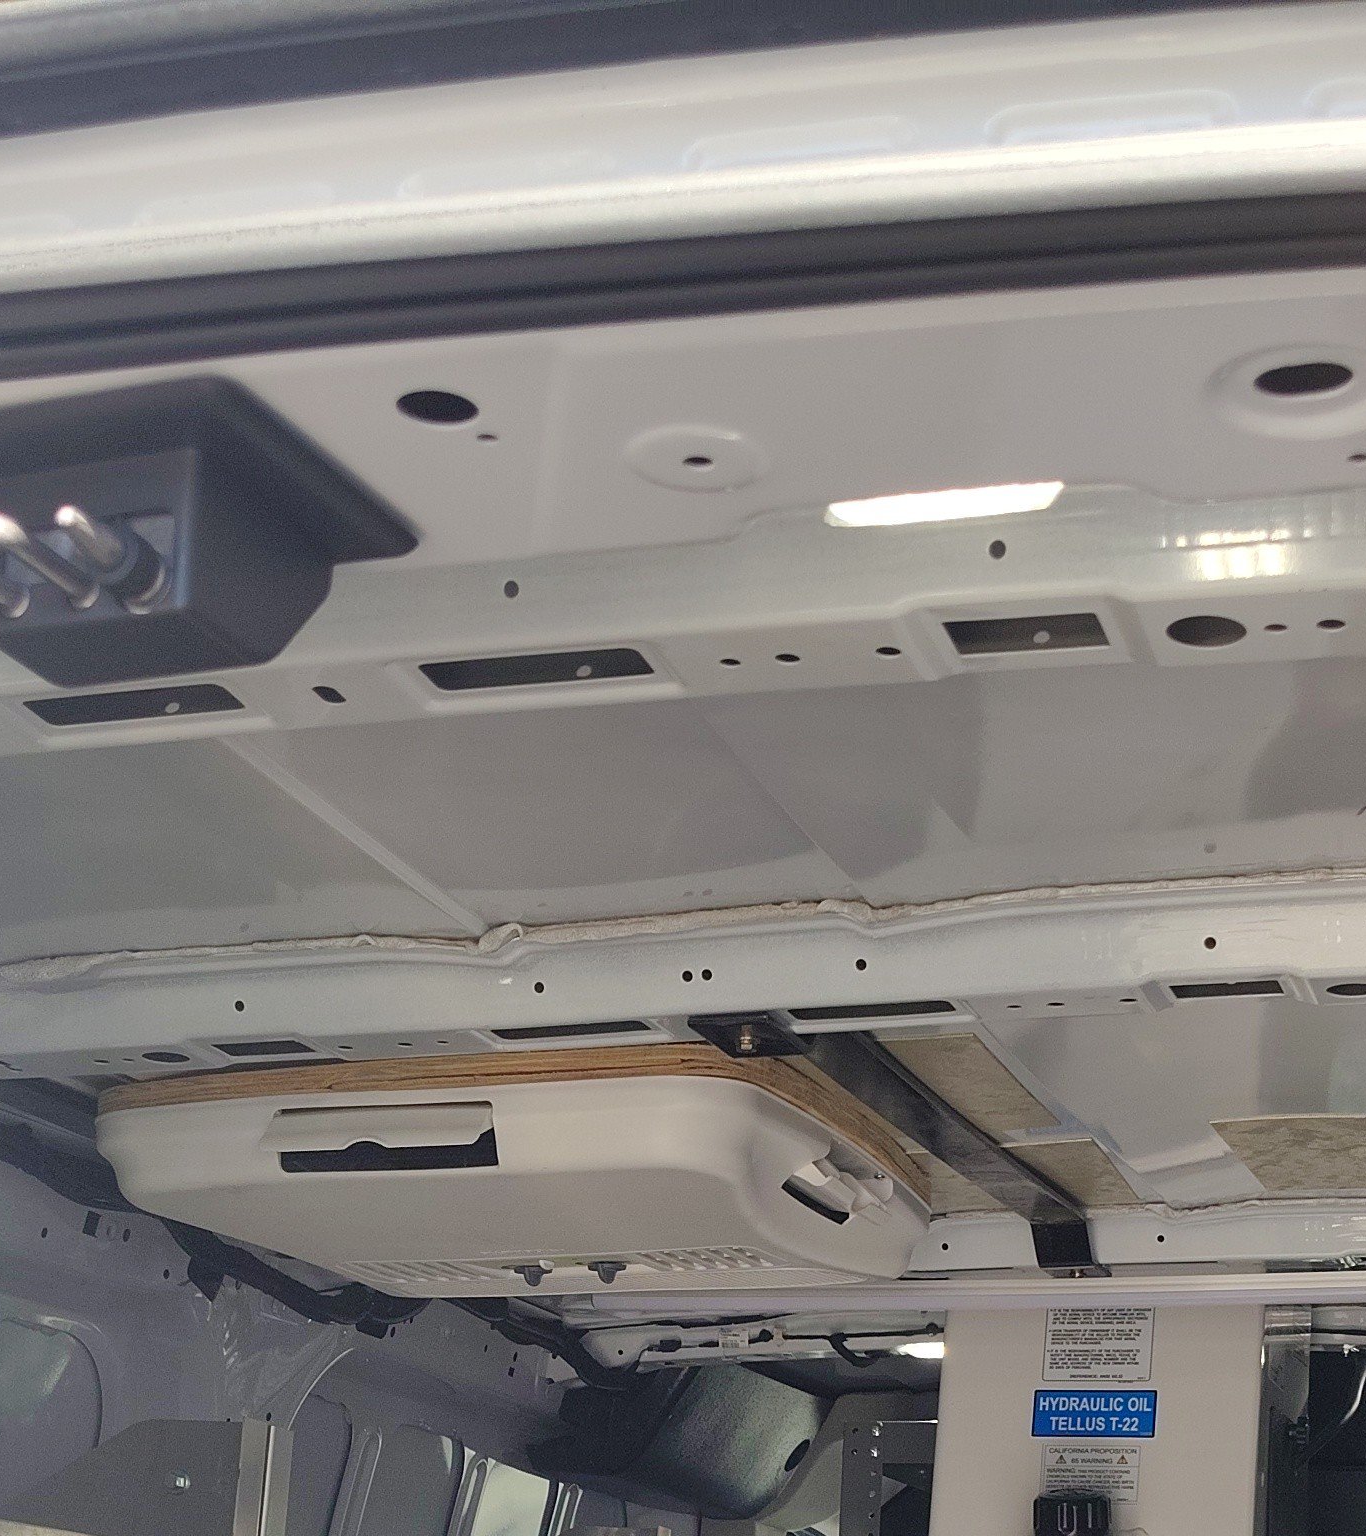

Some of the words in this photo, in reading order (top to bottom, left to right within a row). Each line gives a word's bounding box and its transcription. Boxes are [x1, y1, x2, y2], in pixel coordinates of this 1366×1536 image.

[1039, 1396, 1124, 1411] HYDRAULIC
[1127, 1397, 1152, 1412] OIL
[1049, 1416, 1106, 1431] TELLUS
[1109, 1417, 1139, 1431] T-22
